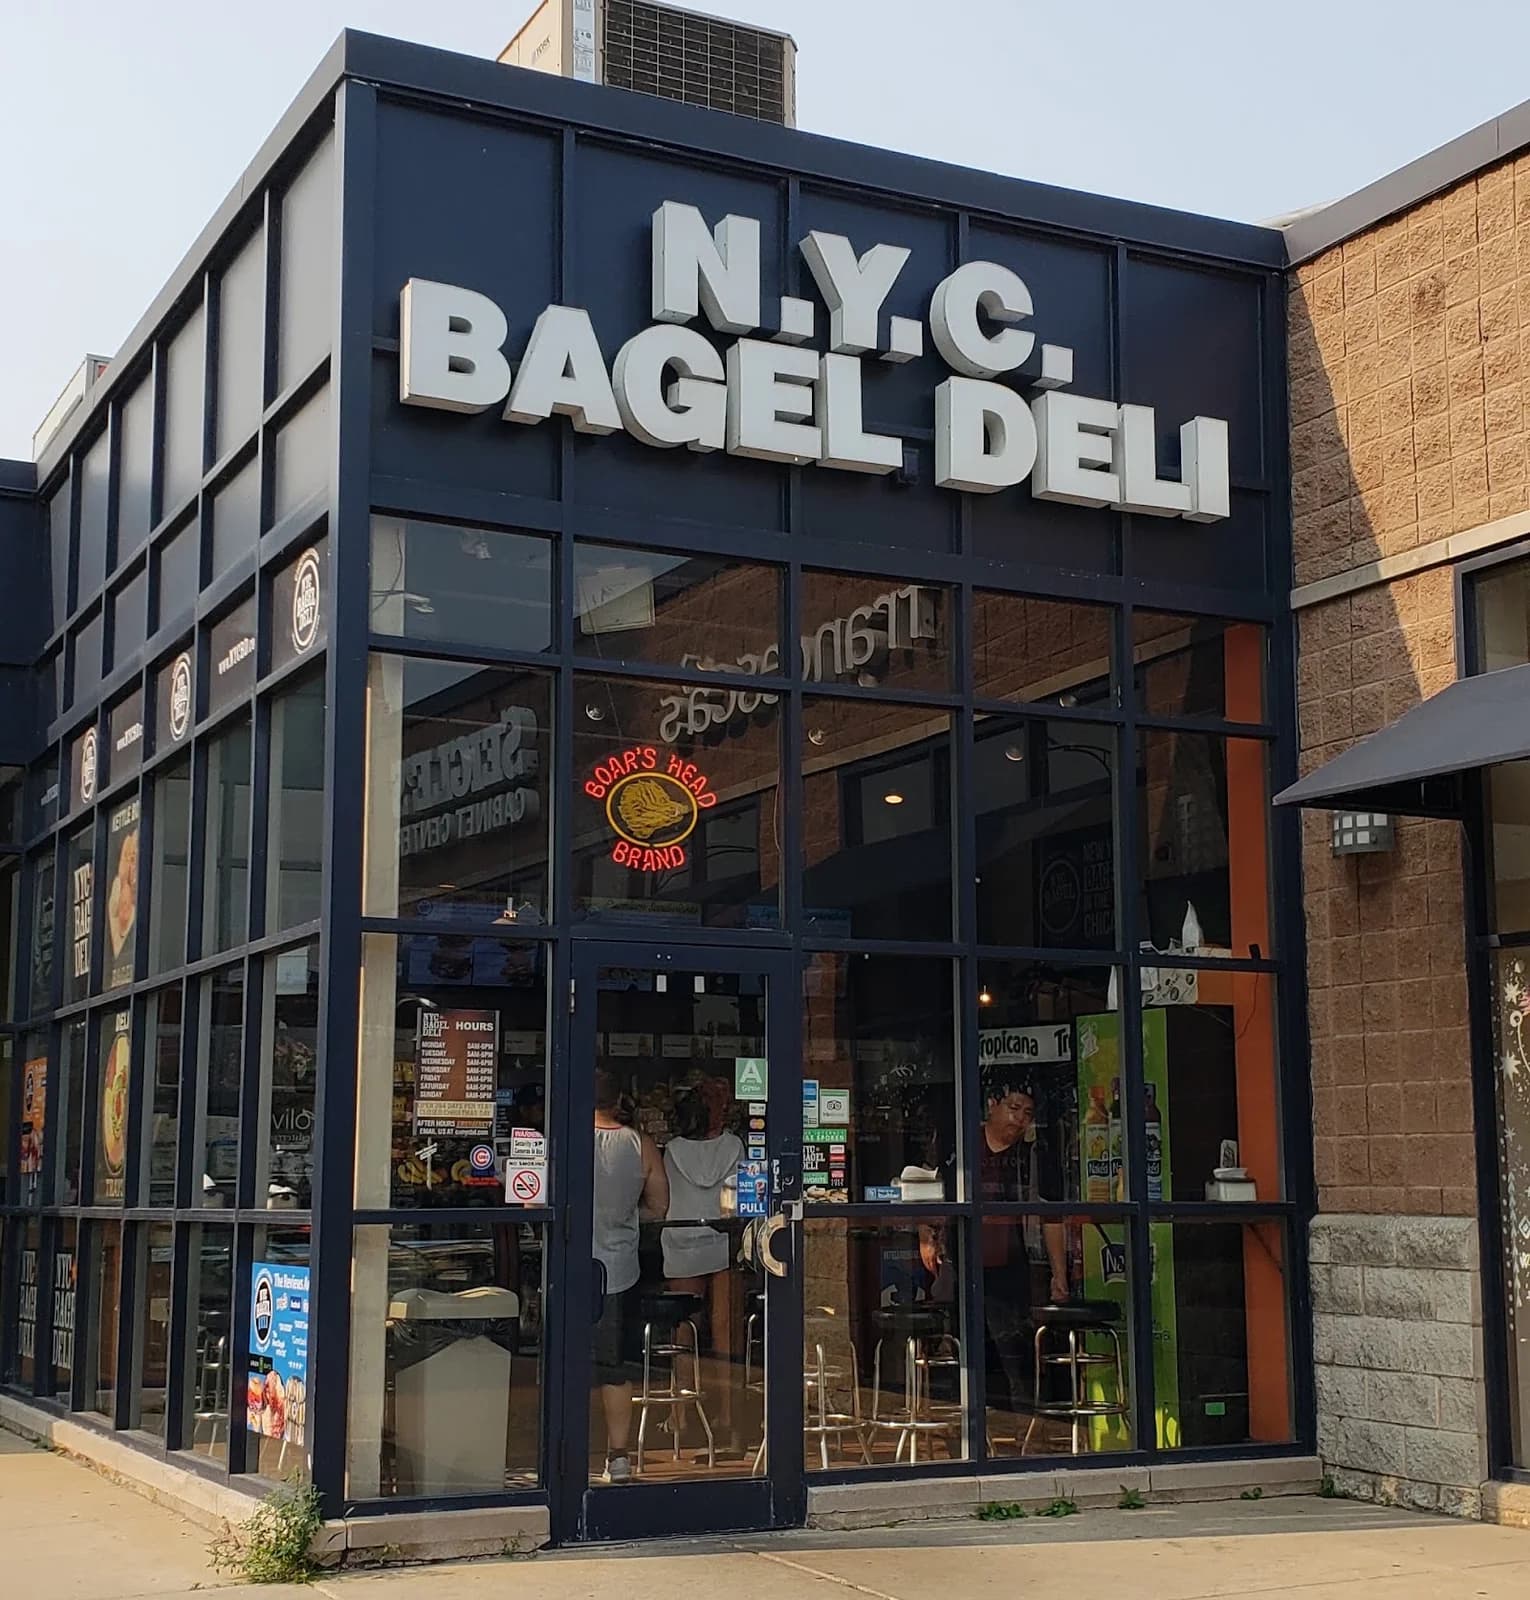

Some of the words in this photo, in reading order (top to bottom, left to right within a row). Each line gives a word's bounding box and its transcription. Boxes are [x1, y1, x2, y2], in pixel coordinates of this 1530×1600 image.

[651, 199, 1074, 388] N.Y.C.
[399, 276, 903, 476] BAGEL
[935, 376, 1230, 524] DELI
[585, 746, 657, 798] BOAR'S
[668, 753, 717, 808] HEAD
[612, 841, 685, 871] BRAND
[455, 1021, 494, 1031] HOURS
[421, 1041, 446, 1049] MONDAY
[421, 1049, 447, 1057] TUESDAY
[979, 1031, 1039, 1059] ropicana
[1054, 1028, 1071, 1057] Tr
[420, 1074, 441, 1082] FRIDAY
[740, 1060, 763, 1084] A
[420, 1082, 450, 1090] SATURDAY
[417, 1119, 435, 1127] AFTER
[740, 1203, 765, 1213] PULL
[55, 1253, 72, 1288] NYC
[1106, 1247, 1126, 1273] Na
[53, 1290, 76, 1329] BAGE
